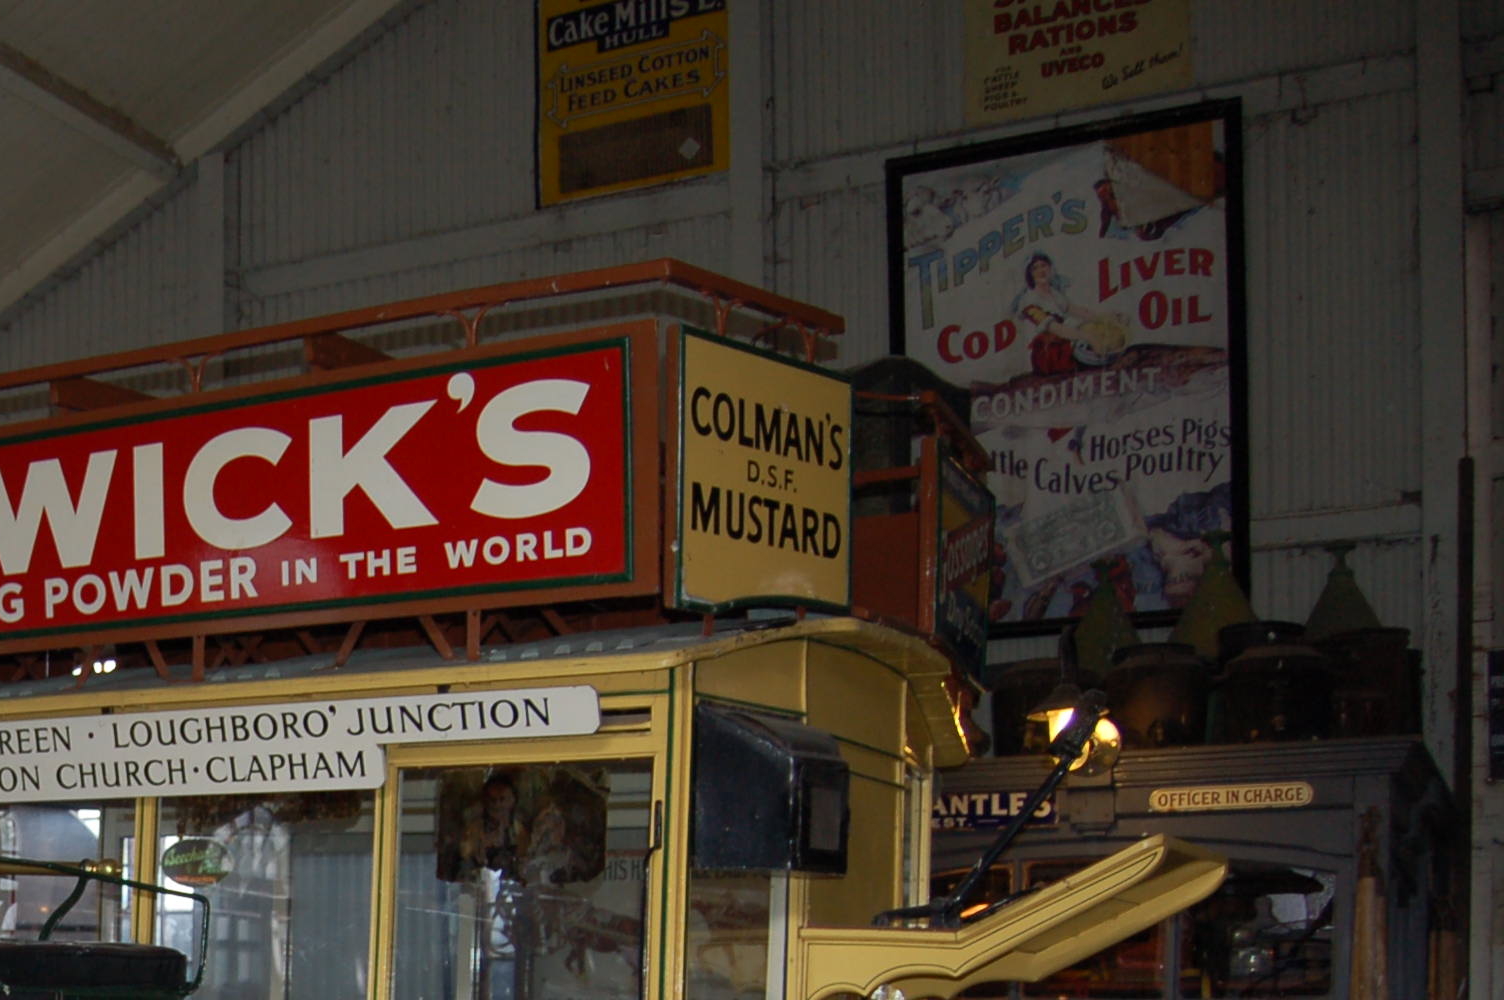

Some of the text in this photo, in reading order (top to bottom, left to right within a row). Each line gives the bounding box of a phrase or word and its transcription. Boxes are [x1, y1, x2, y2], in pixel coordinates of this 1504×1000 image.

[548, 0, 691, 46] Cake Mills
[604, 24, 664, 49] HULL
[994, 0, 1152, 34] BALANCE
[1008, 11, 1138, 55] RATIONS
[560, 46, 709, 93] LINSEED COTTON
[1041, 52, 1105, 78] UVECO
[567, 70, 700, 111] FEED CAKES
[908, 191, 1088, 329] TIPPER'S
[1099, 248, 1214, 302] LIVER
[1138, 290, 1212, 330] OIL
[937, 319, 1016, 363] COD
[972, 367, 1161, 422] CONDIMENT
[690, 387, 843, 471] COLMAN'S
[1090, 418, 1231, 462] Horses Pigs
[747, 461, 798, 496] D.S.F.
[990, 447, 1224, 496] ttle Calves Poultry
[691, 483, 843, 560] MUSTARD
[44, 558, 260, 619] POWDER
[280, 556, 319, 588] IN
[338, 544, 418, 581] THE
[444, 526, 593, 570] WORLD
[110, 703, 339, 750] LOUGHBORO'
[348, 696, 551, 736] JUNCTION
[1157, 786, 1304, 808] OFFICER IN CHARGE
